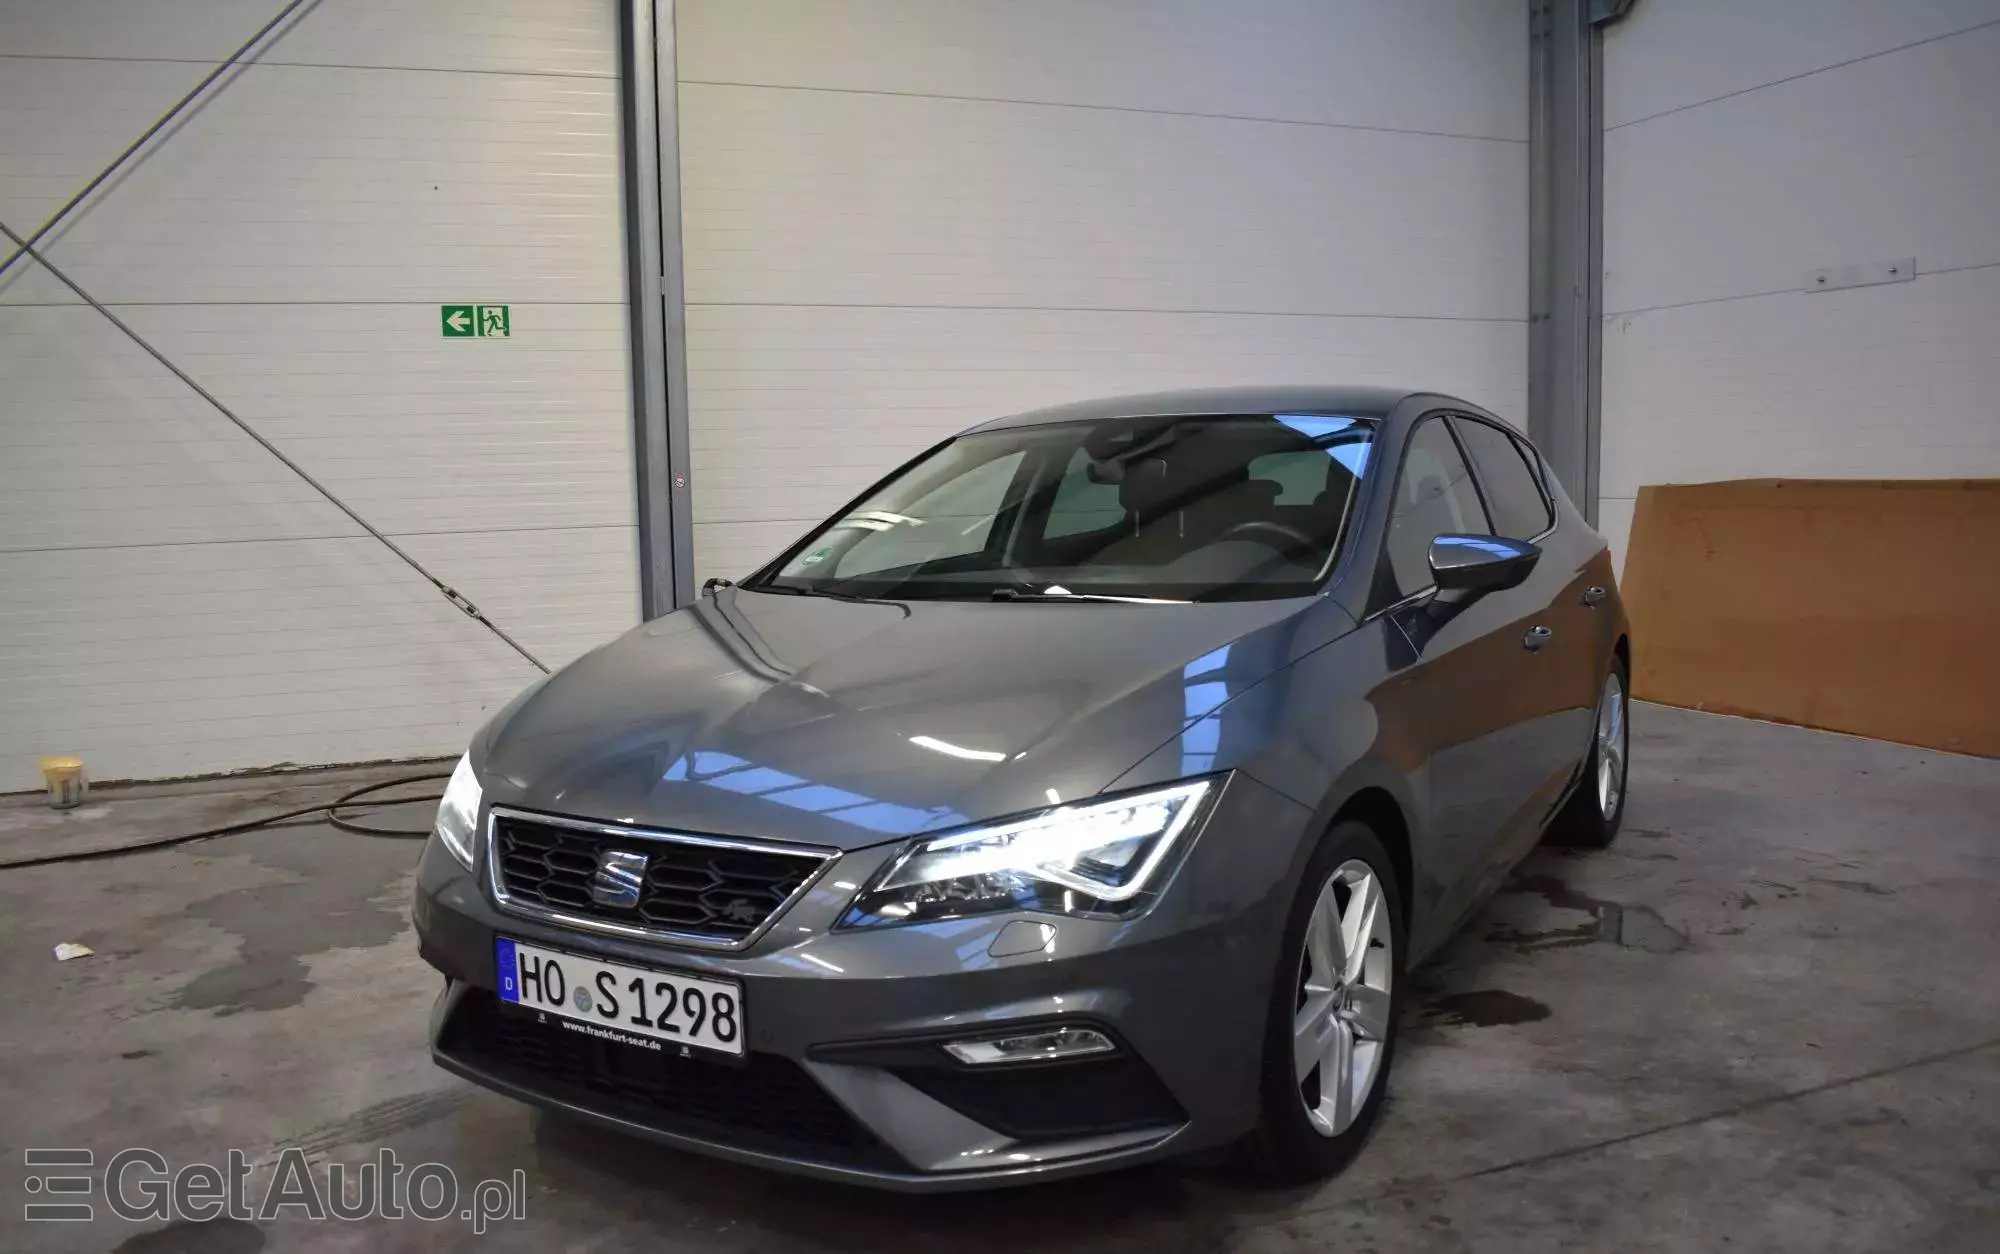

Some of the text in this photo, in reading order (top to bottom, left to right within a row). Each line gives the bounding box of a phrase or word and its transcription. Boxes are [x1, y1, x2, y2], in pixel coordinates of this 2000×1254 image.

[505, 976, 513, 991] D
[519, 952, 566, 1007] HO
[562, 1021, 662, 1051] www.frankfurt-seat.de
